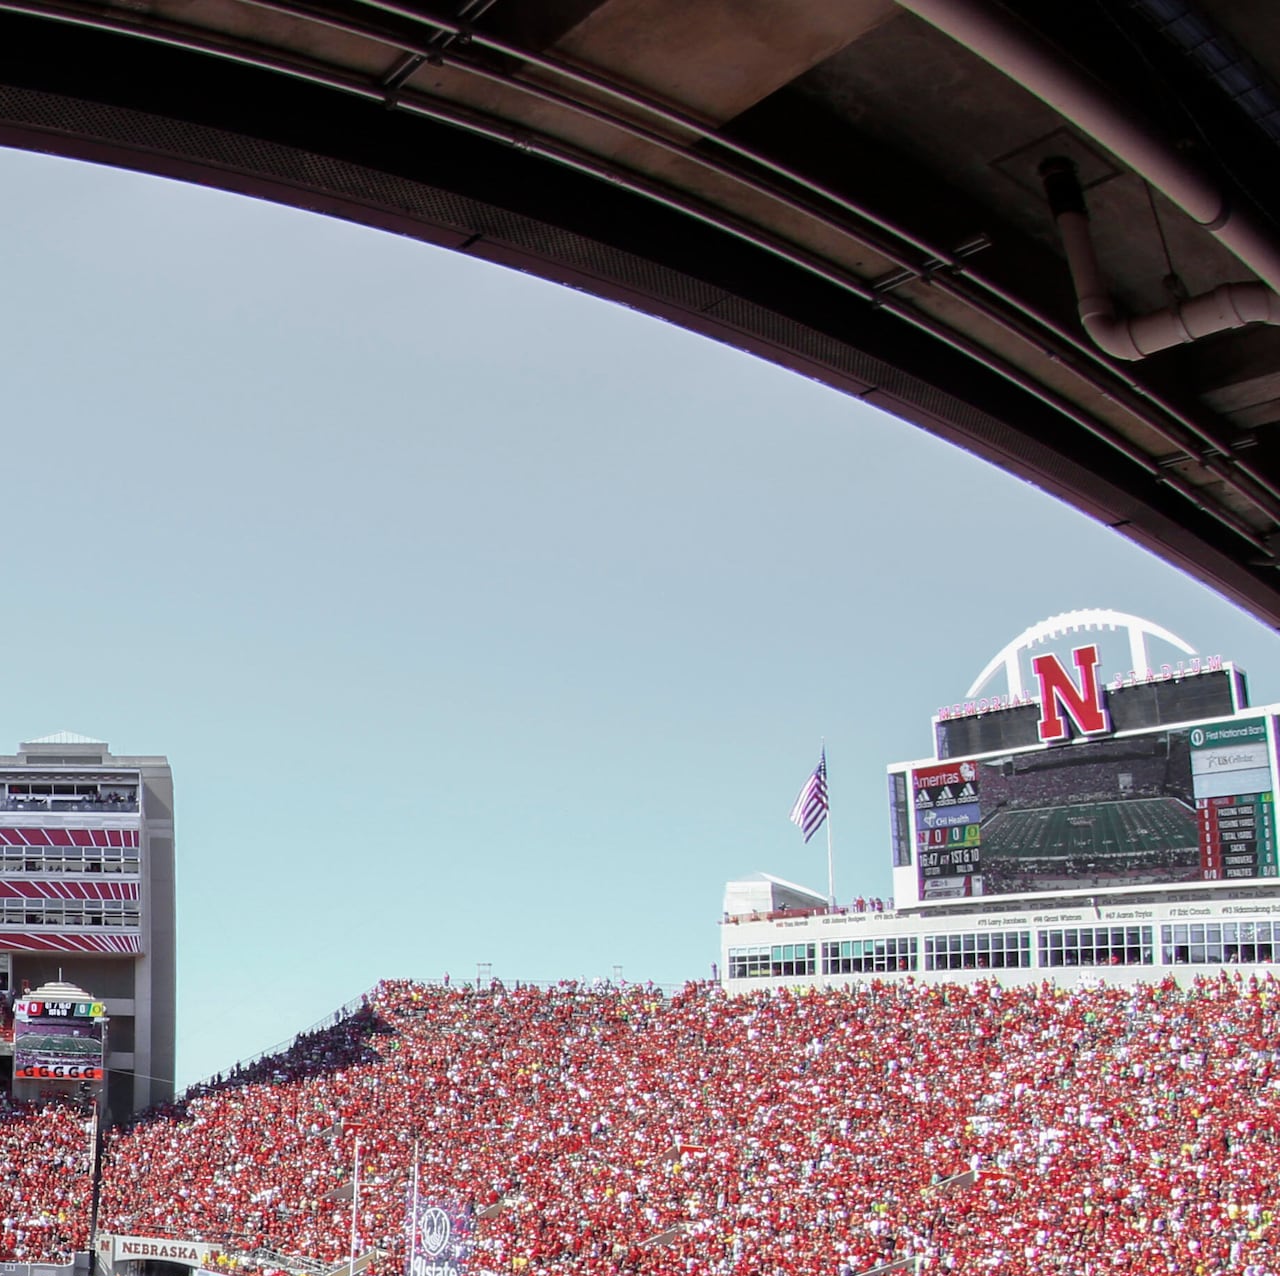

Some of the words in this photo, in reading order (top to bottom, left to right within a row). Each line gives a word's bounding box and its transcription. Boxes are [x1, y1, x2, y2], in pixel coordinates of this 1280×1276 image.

[938, 688, 1033, 720] MEMORIAL
[1031, 643, 1109, 742] N
[1113, 654, 1224, 689] STADIUM
[1219, 727, 1248, 739] National
[1249, 724, 1265, 736] Bank
[914, 774, 959, 789] Ameritas
[935, 817, 947, 826] CHI
[947, 814, 970, 826] Health
[935, 829, 942, 843] 0
[952, 828, 959, 841] 0
[31, 1003, 37, 1012] 0
[79, 1004, 86, 1013] 0
[100, 1239, 110, 1252] N
[122, 1241, 199, 1260] NEBRASKA
